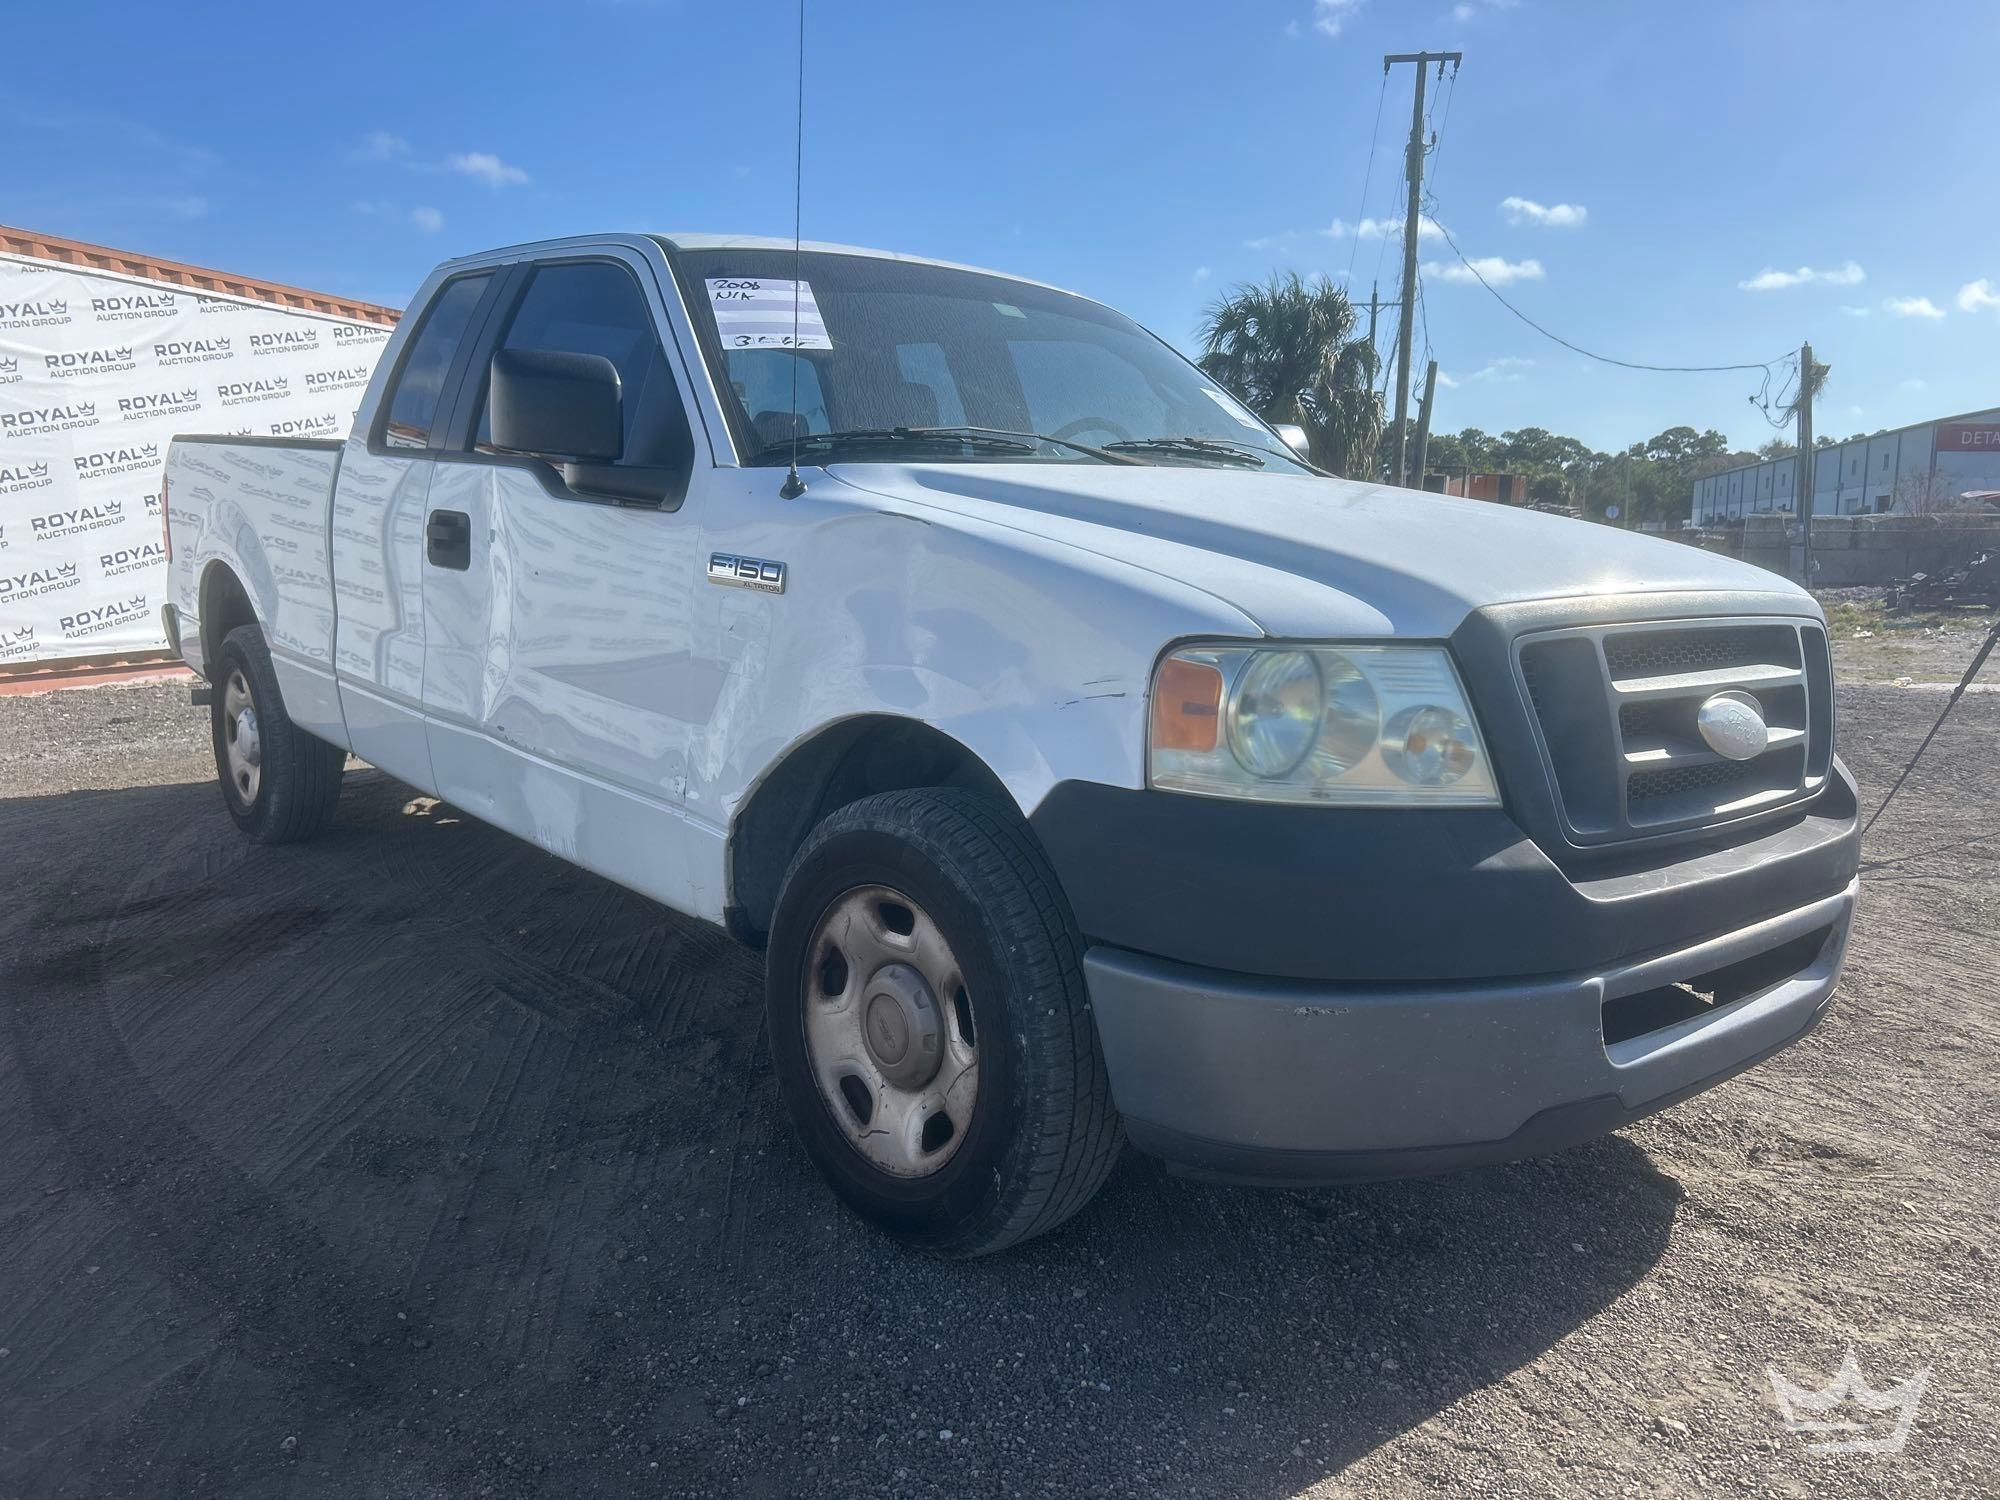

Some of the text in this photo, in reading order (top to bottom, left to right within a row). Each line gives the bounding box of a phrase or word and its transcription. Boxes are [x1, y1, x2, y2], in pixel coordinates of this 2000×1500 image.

[0, 302, 49, 319] YAL
[92, 295, 160, 312] ROYAL
[200, 304, 240, 314] AUCTION
[0, 316, 72, 329] TION GROUP
[96, 309, 178, 322] AUCTION GROUP
[154, 338, 216, 357] ROYAL
[250, 331, 304, 347] ROYAL
[337, 337, 369, 347] AUCTION
[253, 342, 320, 356] AUCTION GROUP
[45, 349, 116, 368] ROYAL
[158, 351, 234, 367] AUCTION GROUP
[50, 362, 136, 379] AUCTION GROUP
[305, 369, 355, 385] ROYAL
[218, 379, 275, 398] ROYAL
[309, 383, 343, 394] AUCTION
[118, 391, 183, 411] ROYAL
[222, 390, 291, 407] AUCTION GROUP
[1, 405, 79, 428] ROYAL
[123, 403, 201, 421] AUCTION GROUP
[6, 418, 100, 438] AUCTION GROUP
[271, 417, 323, 435] ROYAL
[73, 447, 142, 470] ROYAL
[79, 458, 162, 480] AUCTION GROUP
[10, 478, 53, 493] GROUP
[31, 505, 105, 531] ROYAL
[36, 515, 126, 541] AUCTION GROUP
[100, 542, 165, 568] ROYAL
[104, 560, 150, 578] AUCTION
[0, 569, 58, 593] OYAL
[754, 583, 780, 593] TRITON
[0, 577, 81, 604] CTION GROUP
[59, 601, 130, 630] ROYAL
[65, 609, 151, 640] AUCTION GROUP
